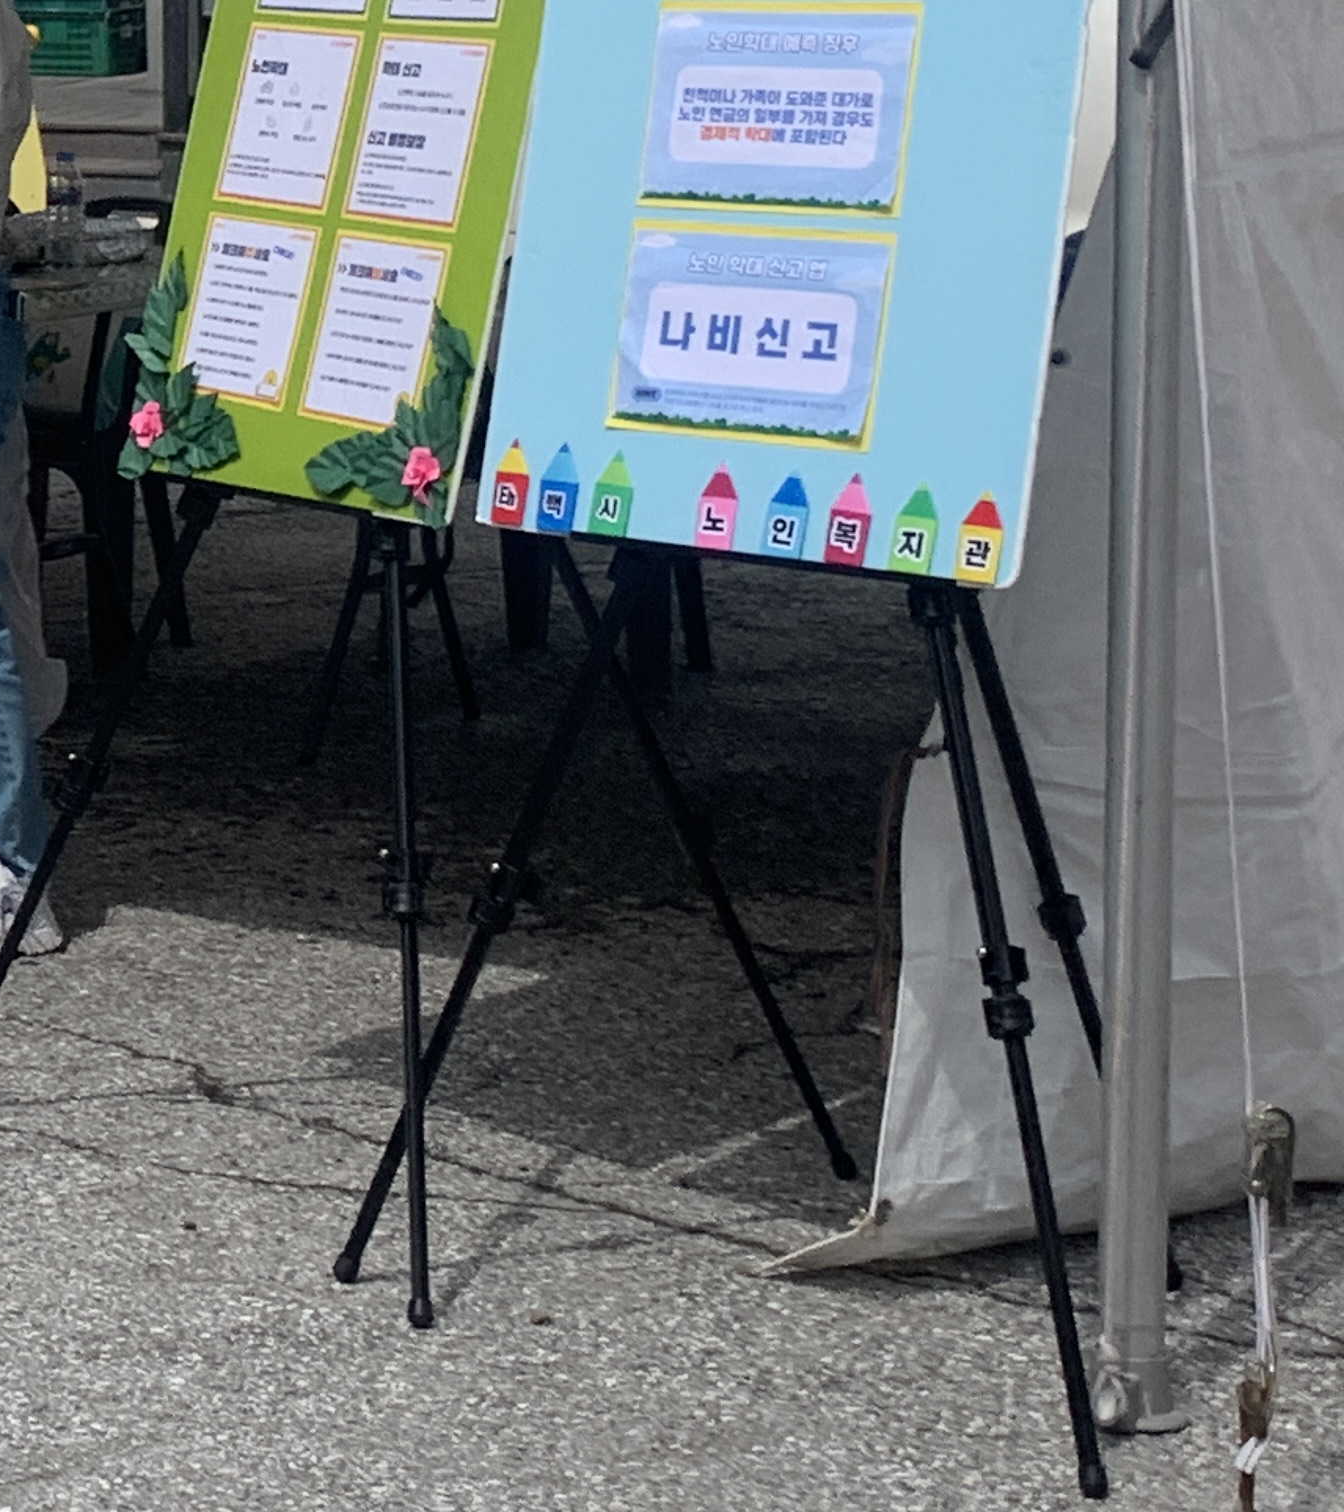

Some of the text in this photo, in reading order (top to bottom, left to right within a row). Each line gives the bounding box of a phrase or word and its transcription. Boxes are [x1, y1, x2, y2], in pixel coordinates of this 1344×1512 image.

[677, 105, 705, 122] 노인
[687, 252, 725, 274] 노인
[767, 257, 804, 279] 신고
